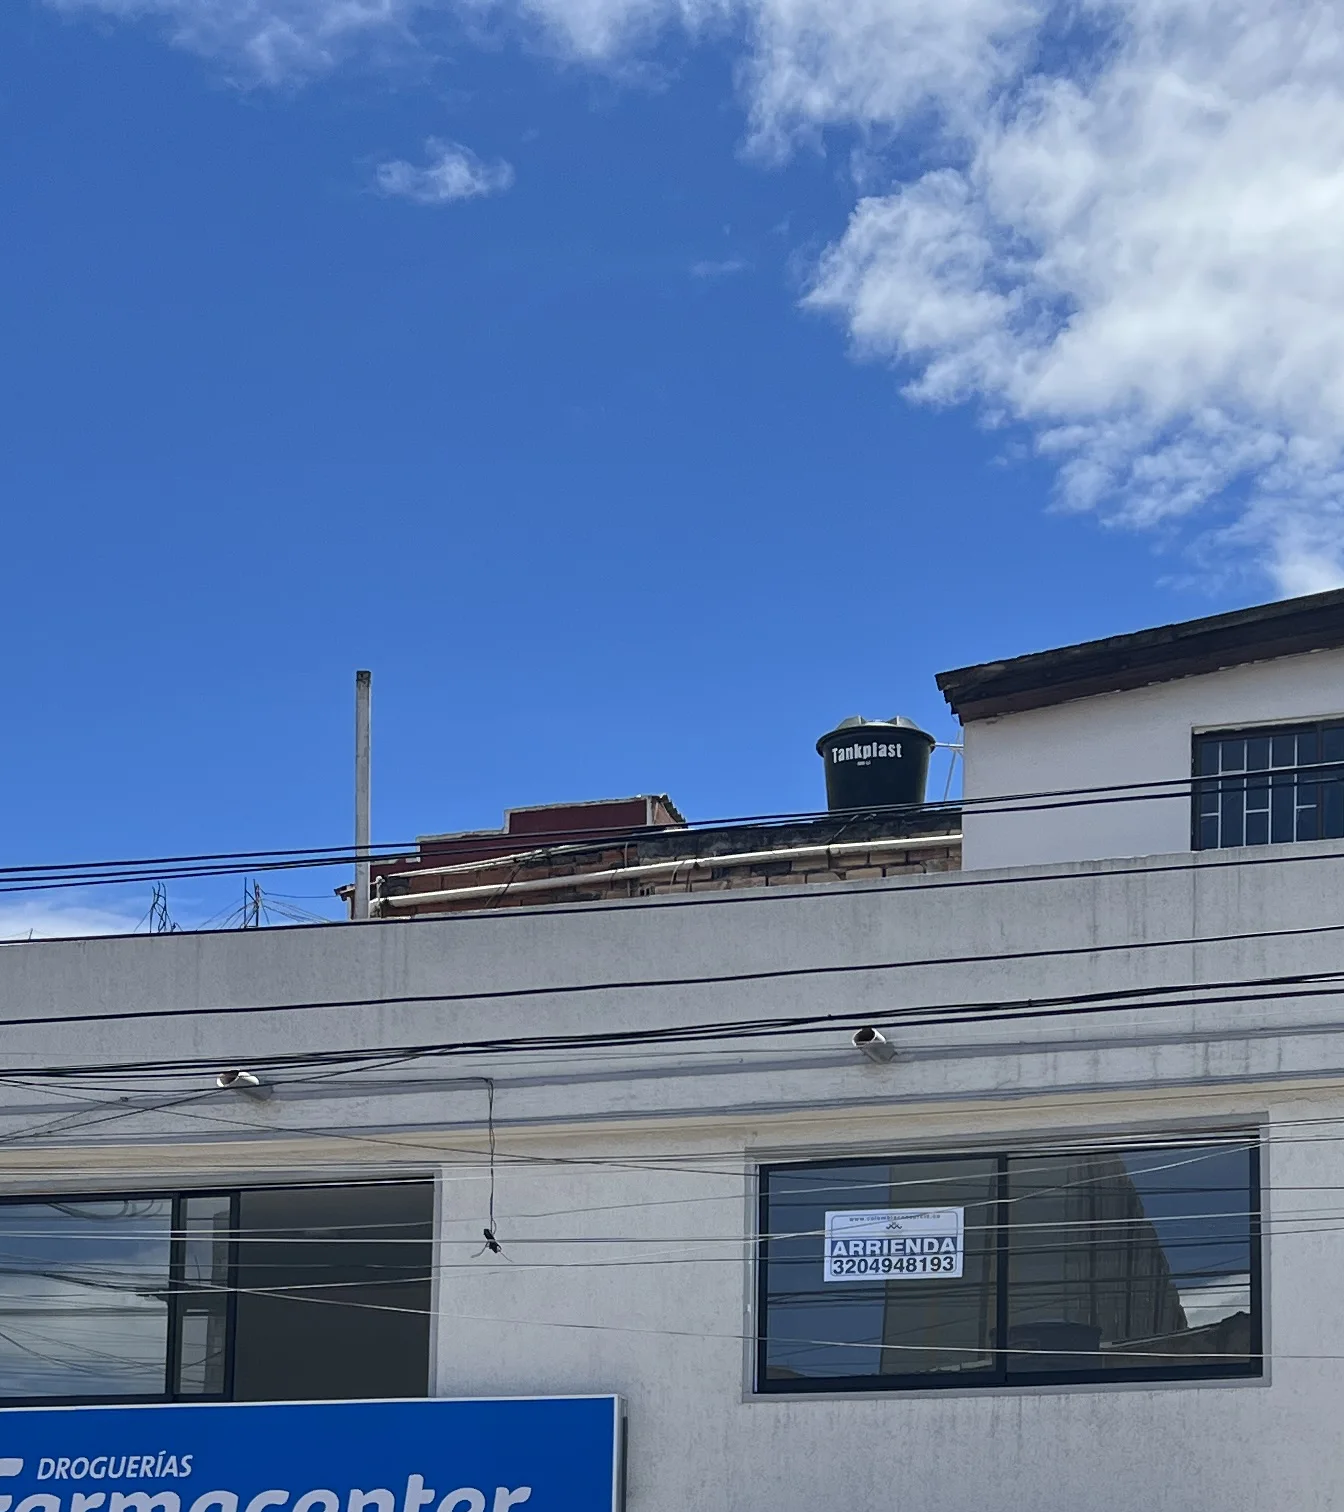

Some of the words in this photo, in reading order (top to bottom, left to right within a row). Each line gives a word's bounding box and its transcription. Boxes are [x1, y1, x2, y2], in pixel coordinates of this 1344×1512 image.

[832, 742, 902, 763] Tankplast
[832, 1238, 956, 1256] ARRIENDA
[833, 1256, 955, 1274] 3204948193
[37, 1450, 194, 1480] DROGUERÍAS
